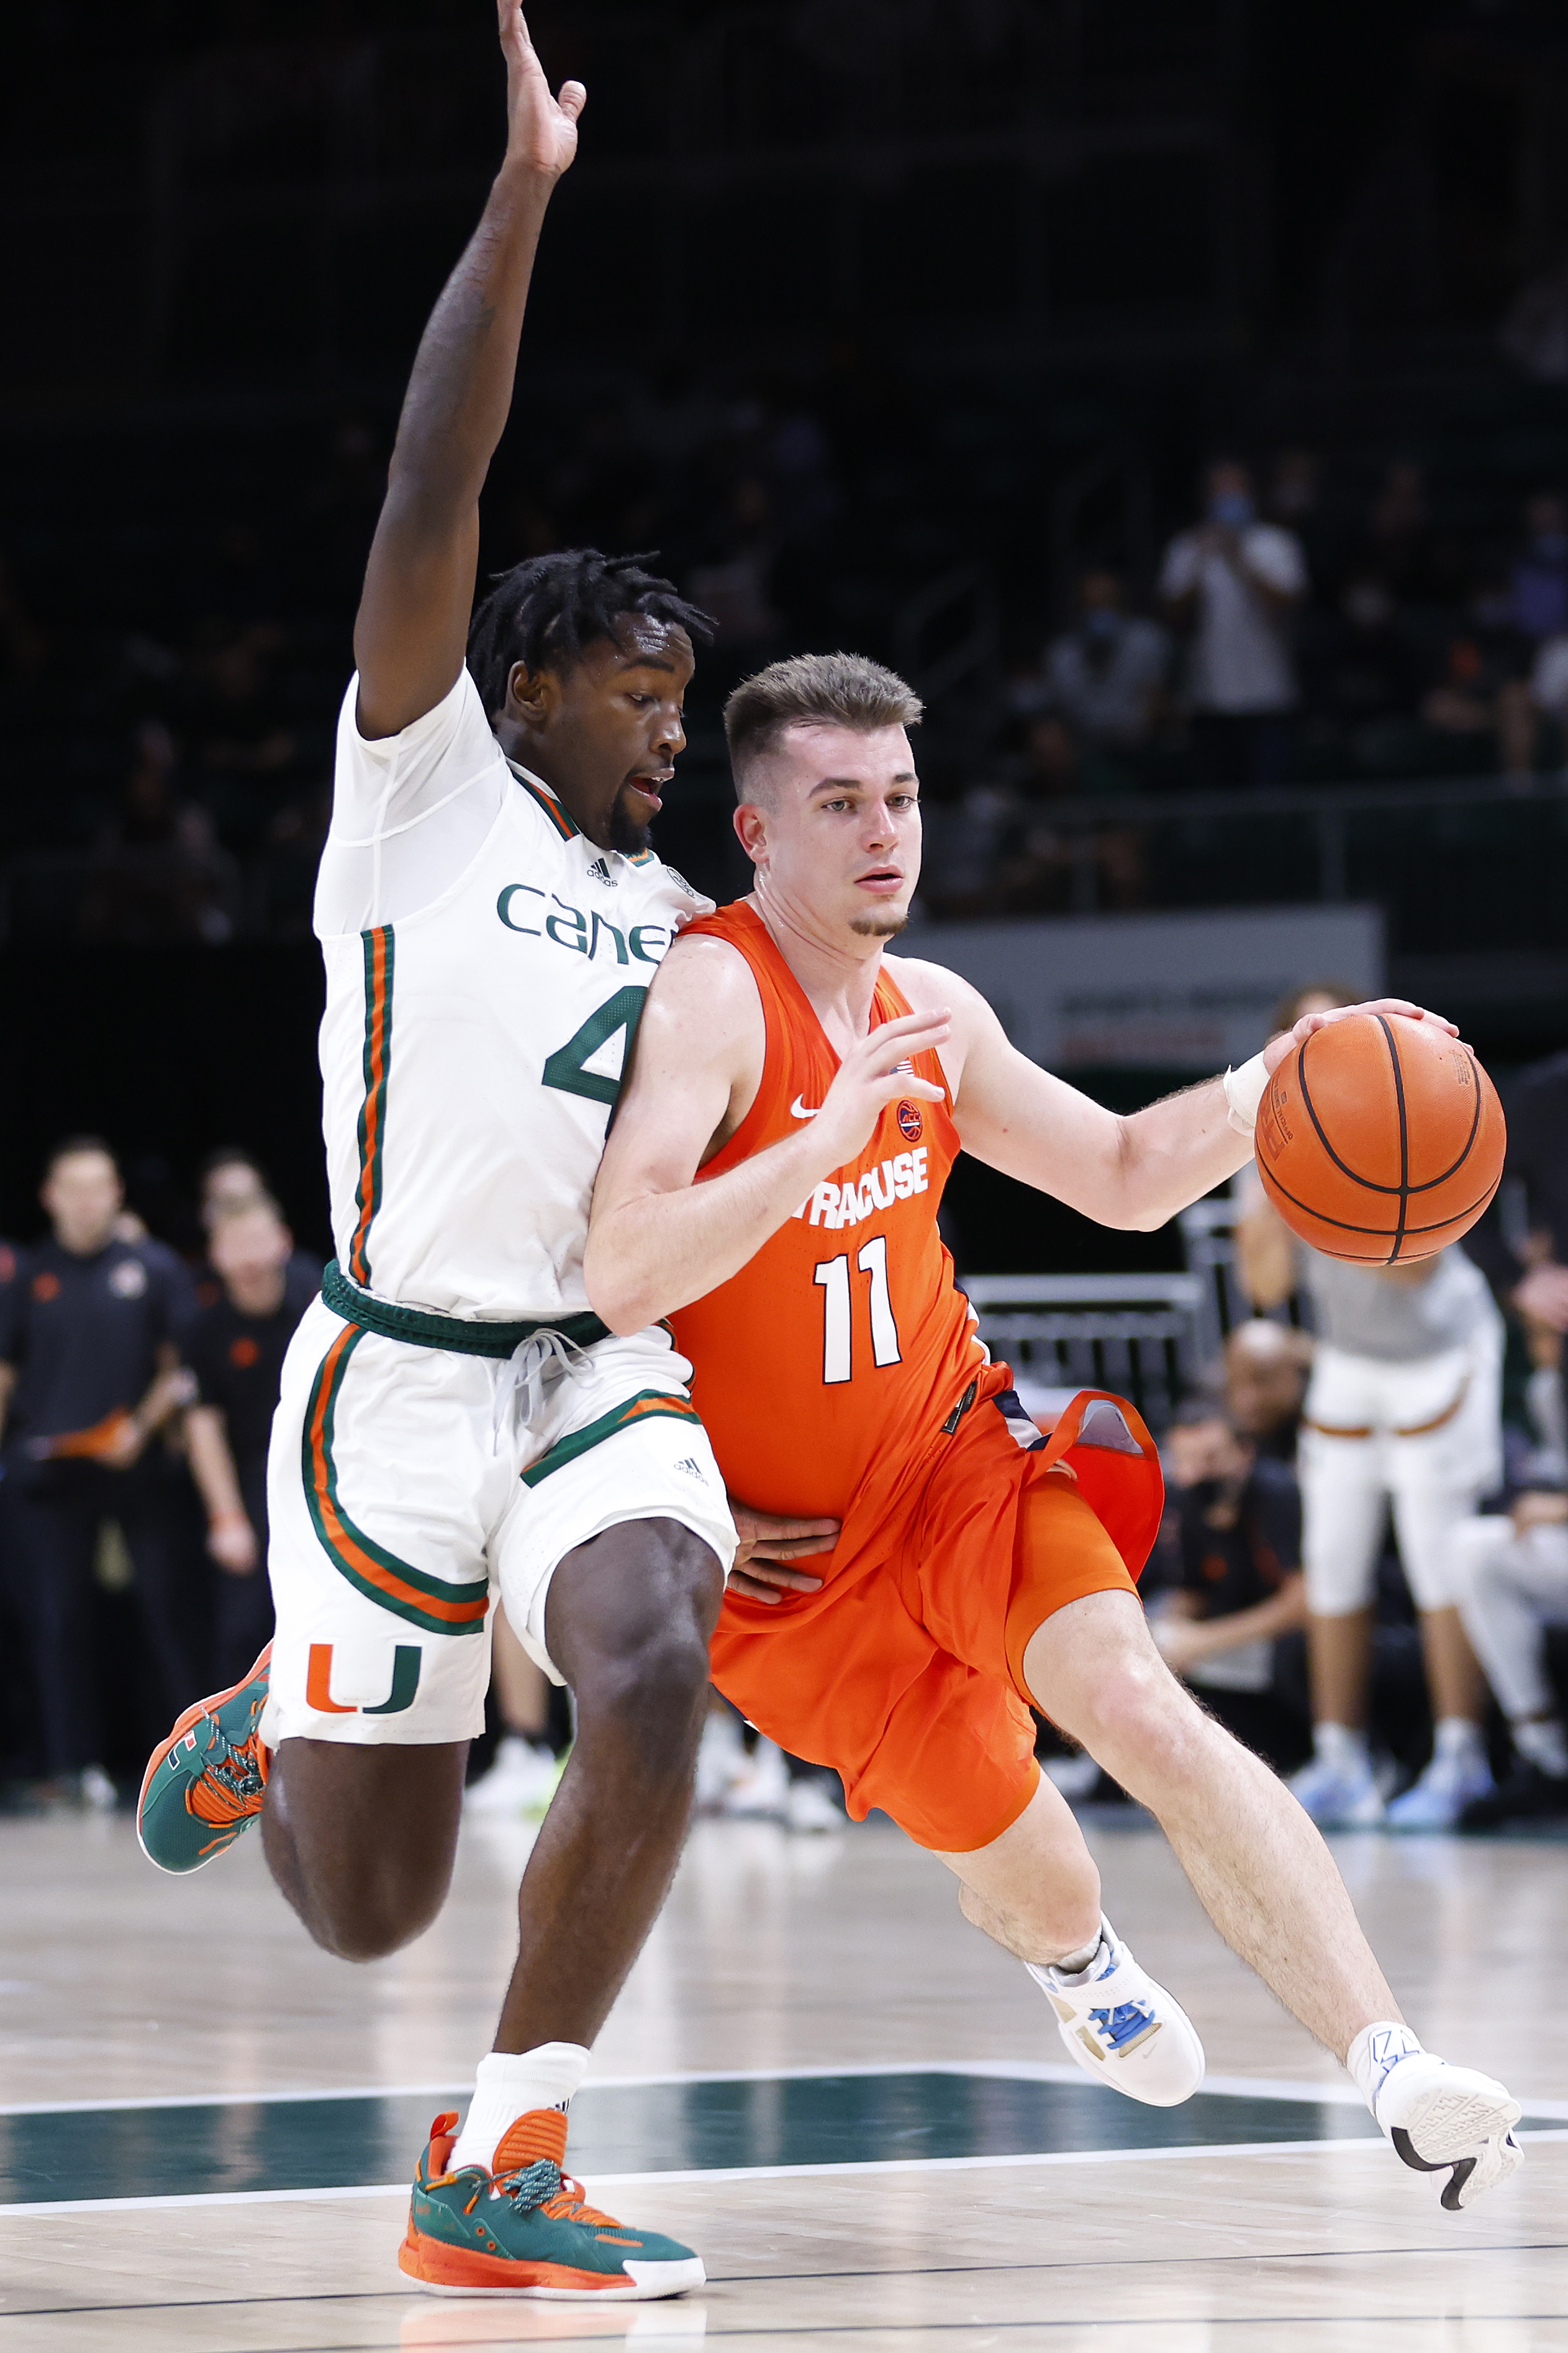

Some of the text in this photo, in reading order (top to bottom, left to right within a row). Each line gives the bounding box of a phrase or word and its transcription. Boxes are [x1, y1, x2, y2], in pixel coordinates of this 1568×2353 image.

[587, 869, 619, 887] adas
[542, 985, 649, 1140] 4
[813, 1235, 902, 1385] 11
[306, 1643, 423, 1714] U
